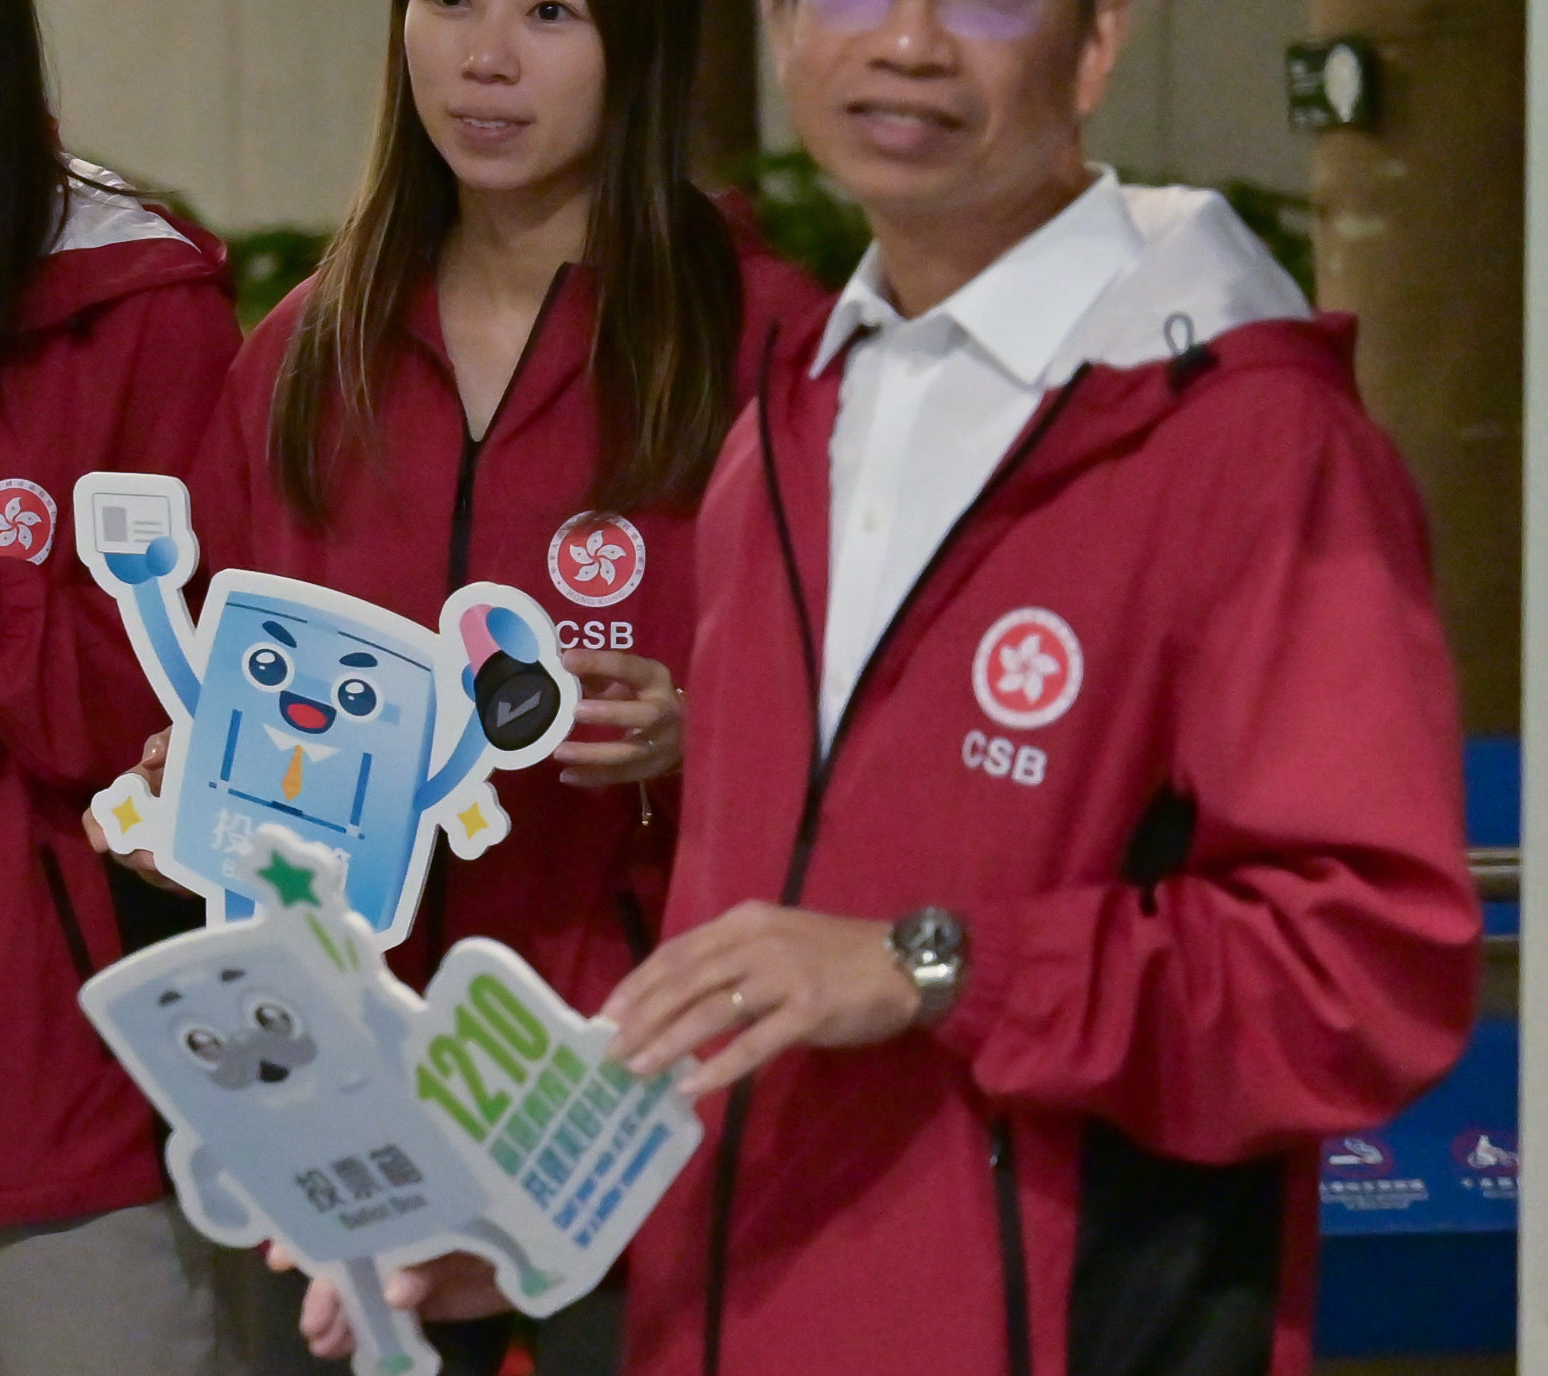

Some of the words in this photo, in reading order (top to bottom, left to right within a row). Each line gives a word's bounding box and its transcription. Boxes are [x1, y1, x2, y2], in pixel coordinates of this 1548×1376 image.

[555, 620, 634, 650] CSB
[962, 729, 1048, 787] CSB
[413, 972, 551, 1145] 1210
